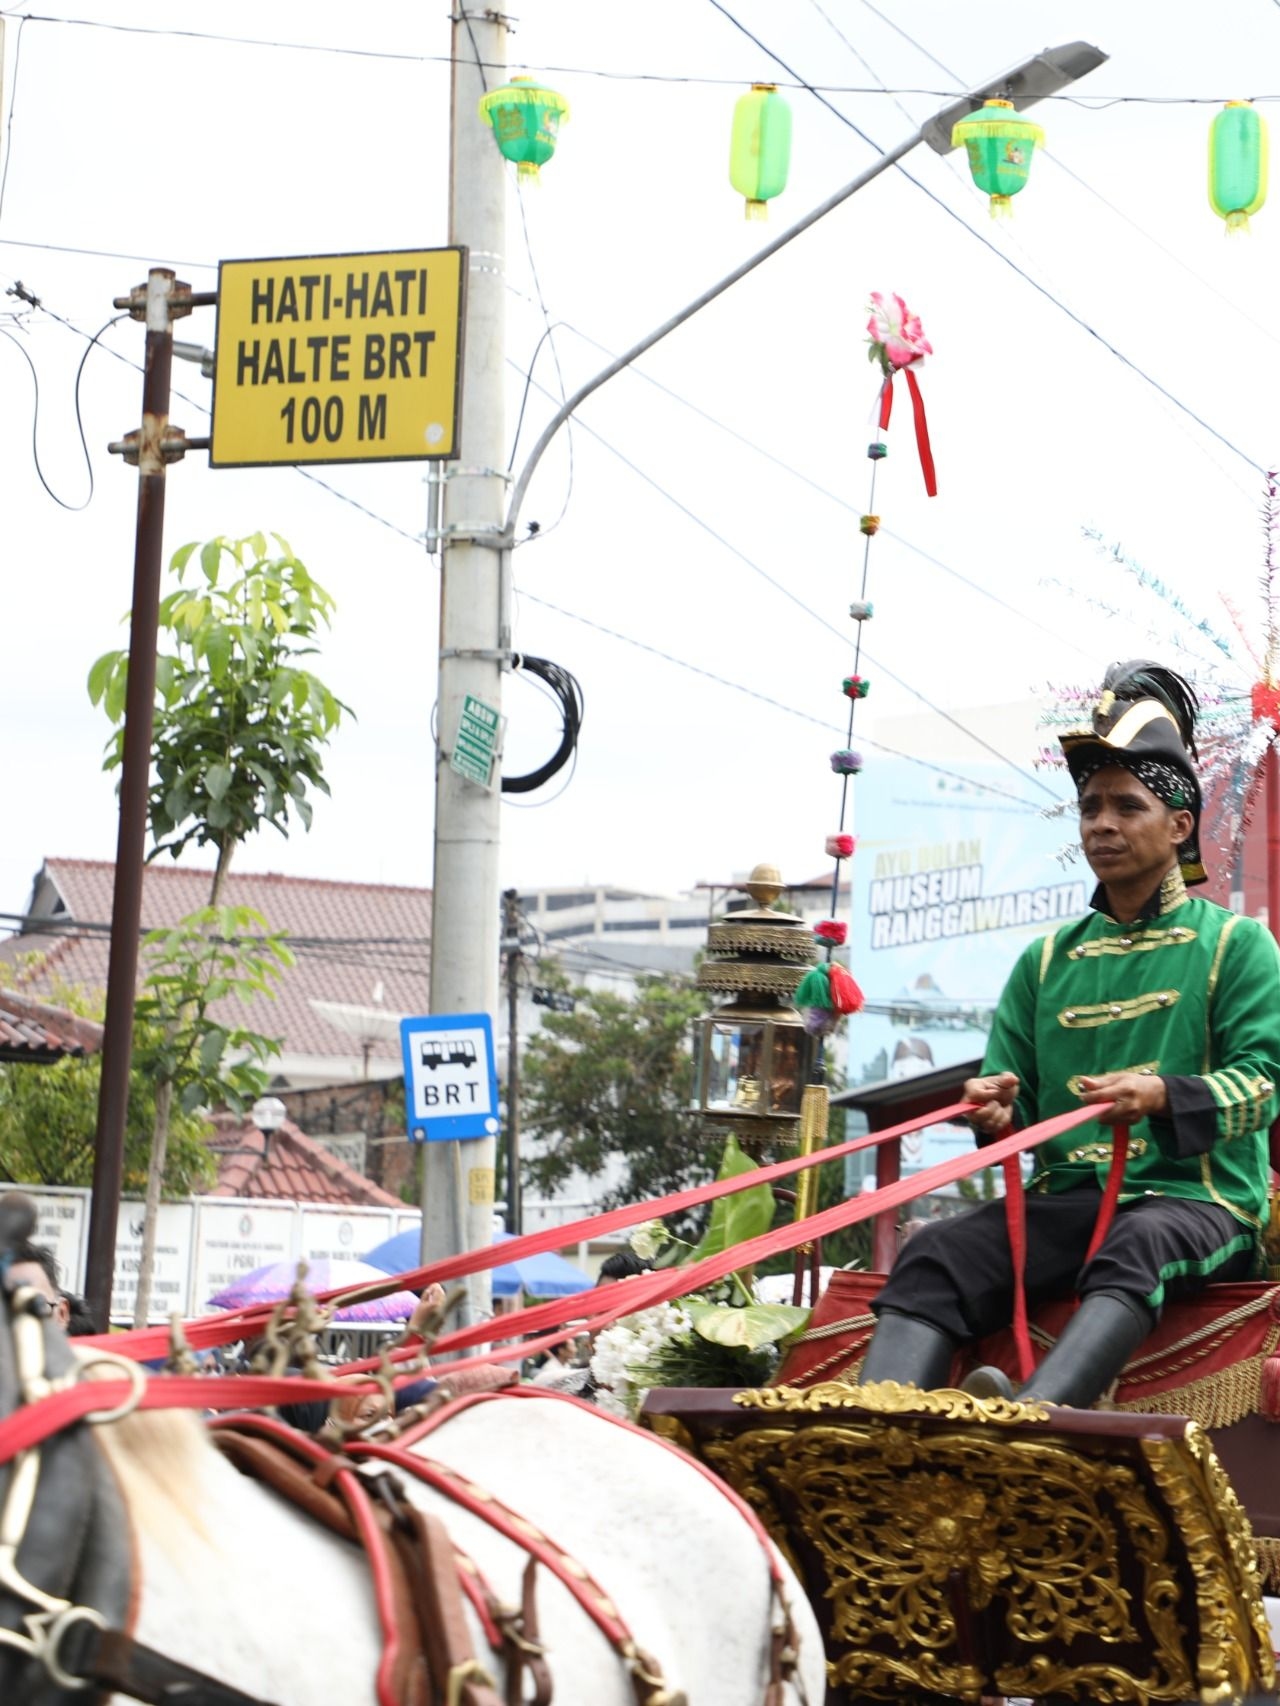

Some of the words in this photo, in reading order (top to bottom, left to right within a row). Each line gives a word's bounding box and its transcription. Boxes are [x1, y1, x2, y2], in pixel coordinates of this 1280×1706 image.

[251, 269, 428, 325] HATI-HATI
[236, 336, 350, 387] HALTE
[363, 331, 436, 381] BRT
[280, 395, 344, 444] 100
[357, 394, 388, 442] M
[869, 864, 984, 916] MUSEUM
[871, 881, 1088, 950] RANGGAWARSITA
[424, 1081, 479, 1107] BRT
